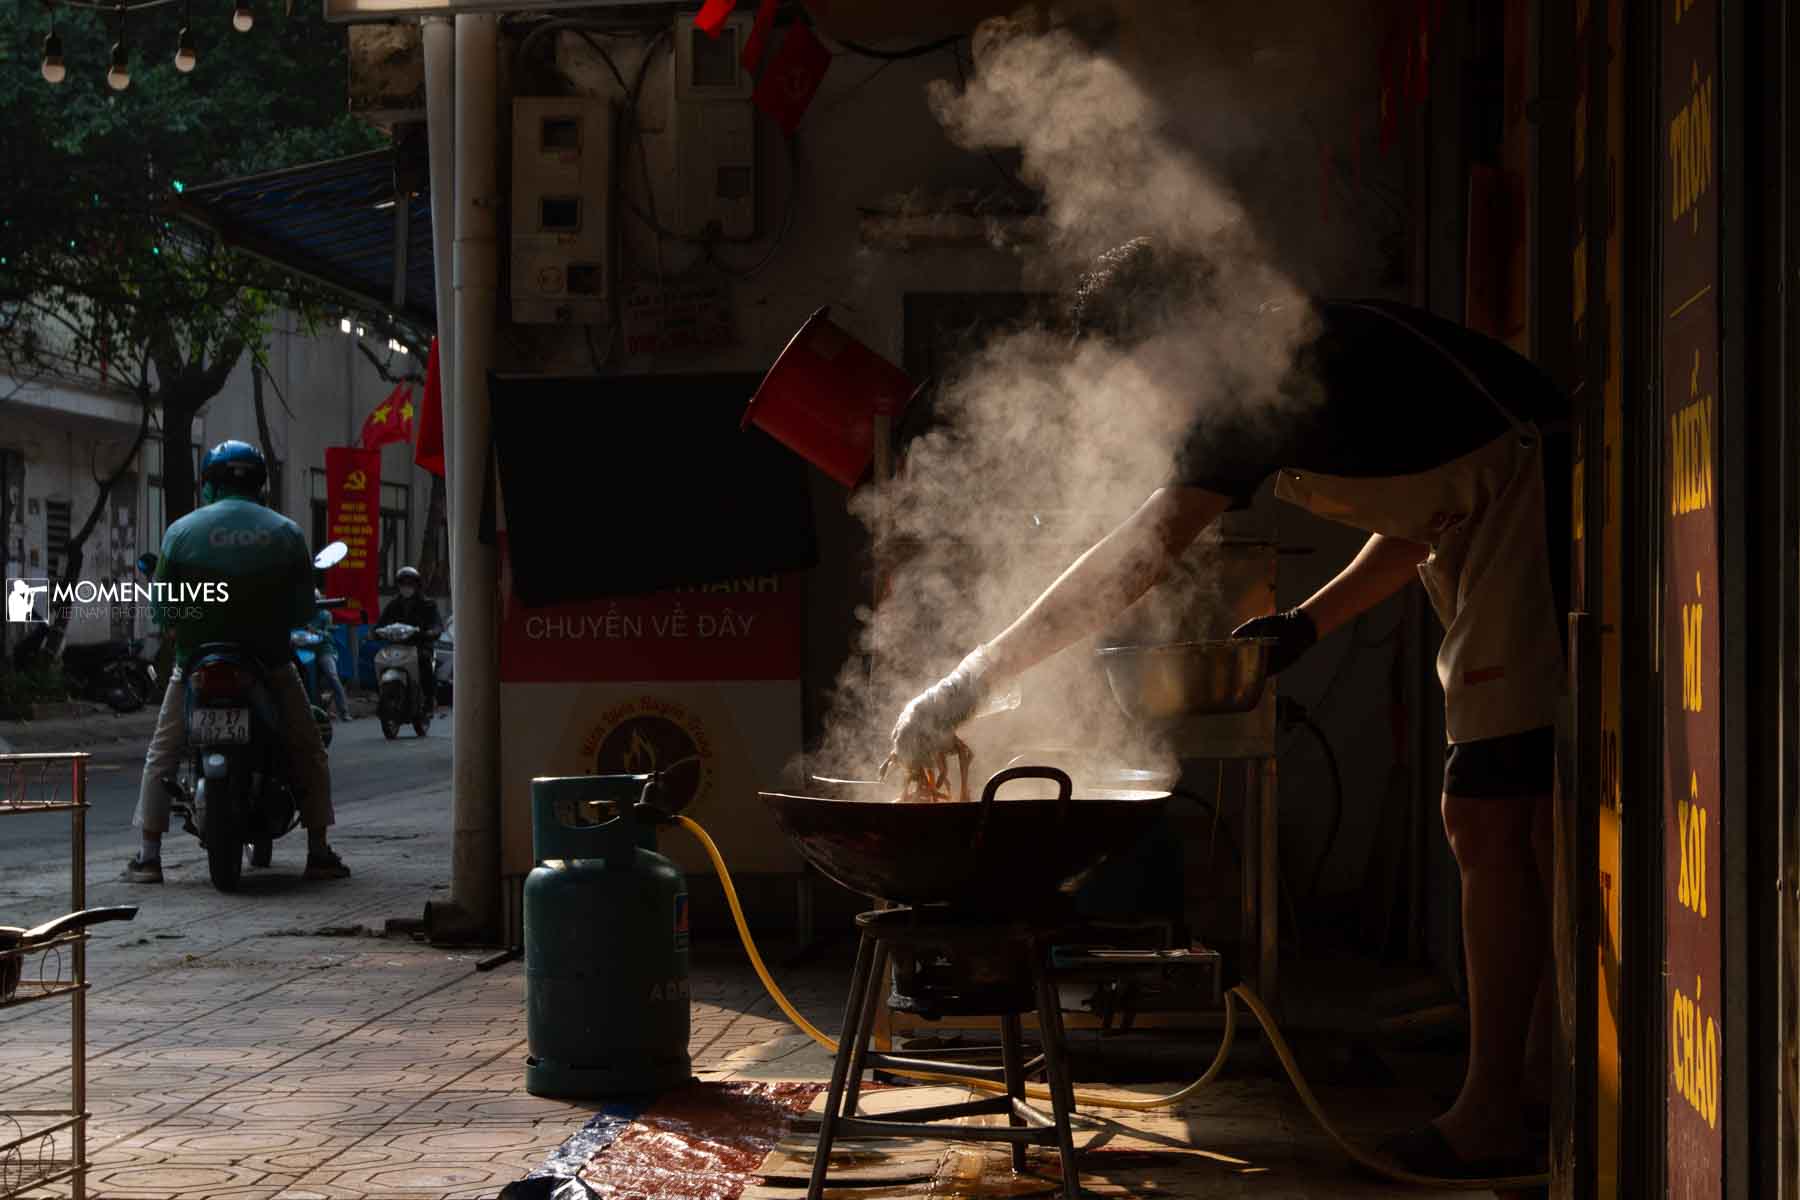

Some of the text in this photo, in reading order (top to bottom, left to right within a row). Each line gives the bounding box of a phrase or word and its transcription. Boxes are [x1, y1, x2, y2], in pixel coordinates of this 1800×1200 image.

[1671, 349, 1712, 516] MIẾN
[695, 607, 755, 639] ĐÂY
[1678, 768, 1707, 918] XÔI
[1673, 975, 1717, 1129] CHÁO
